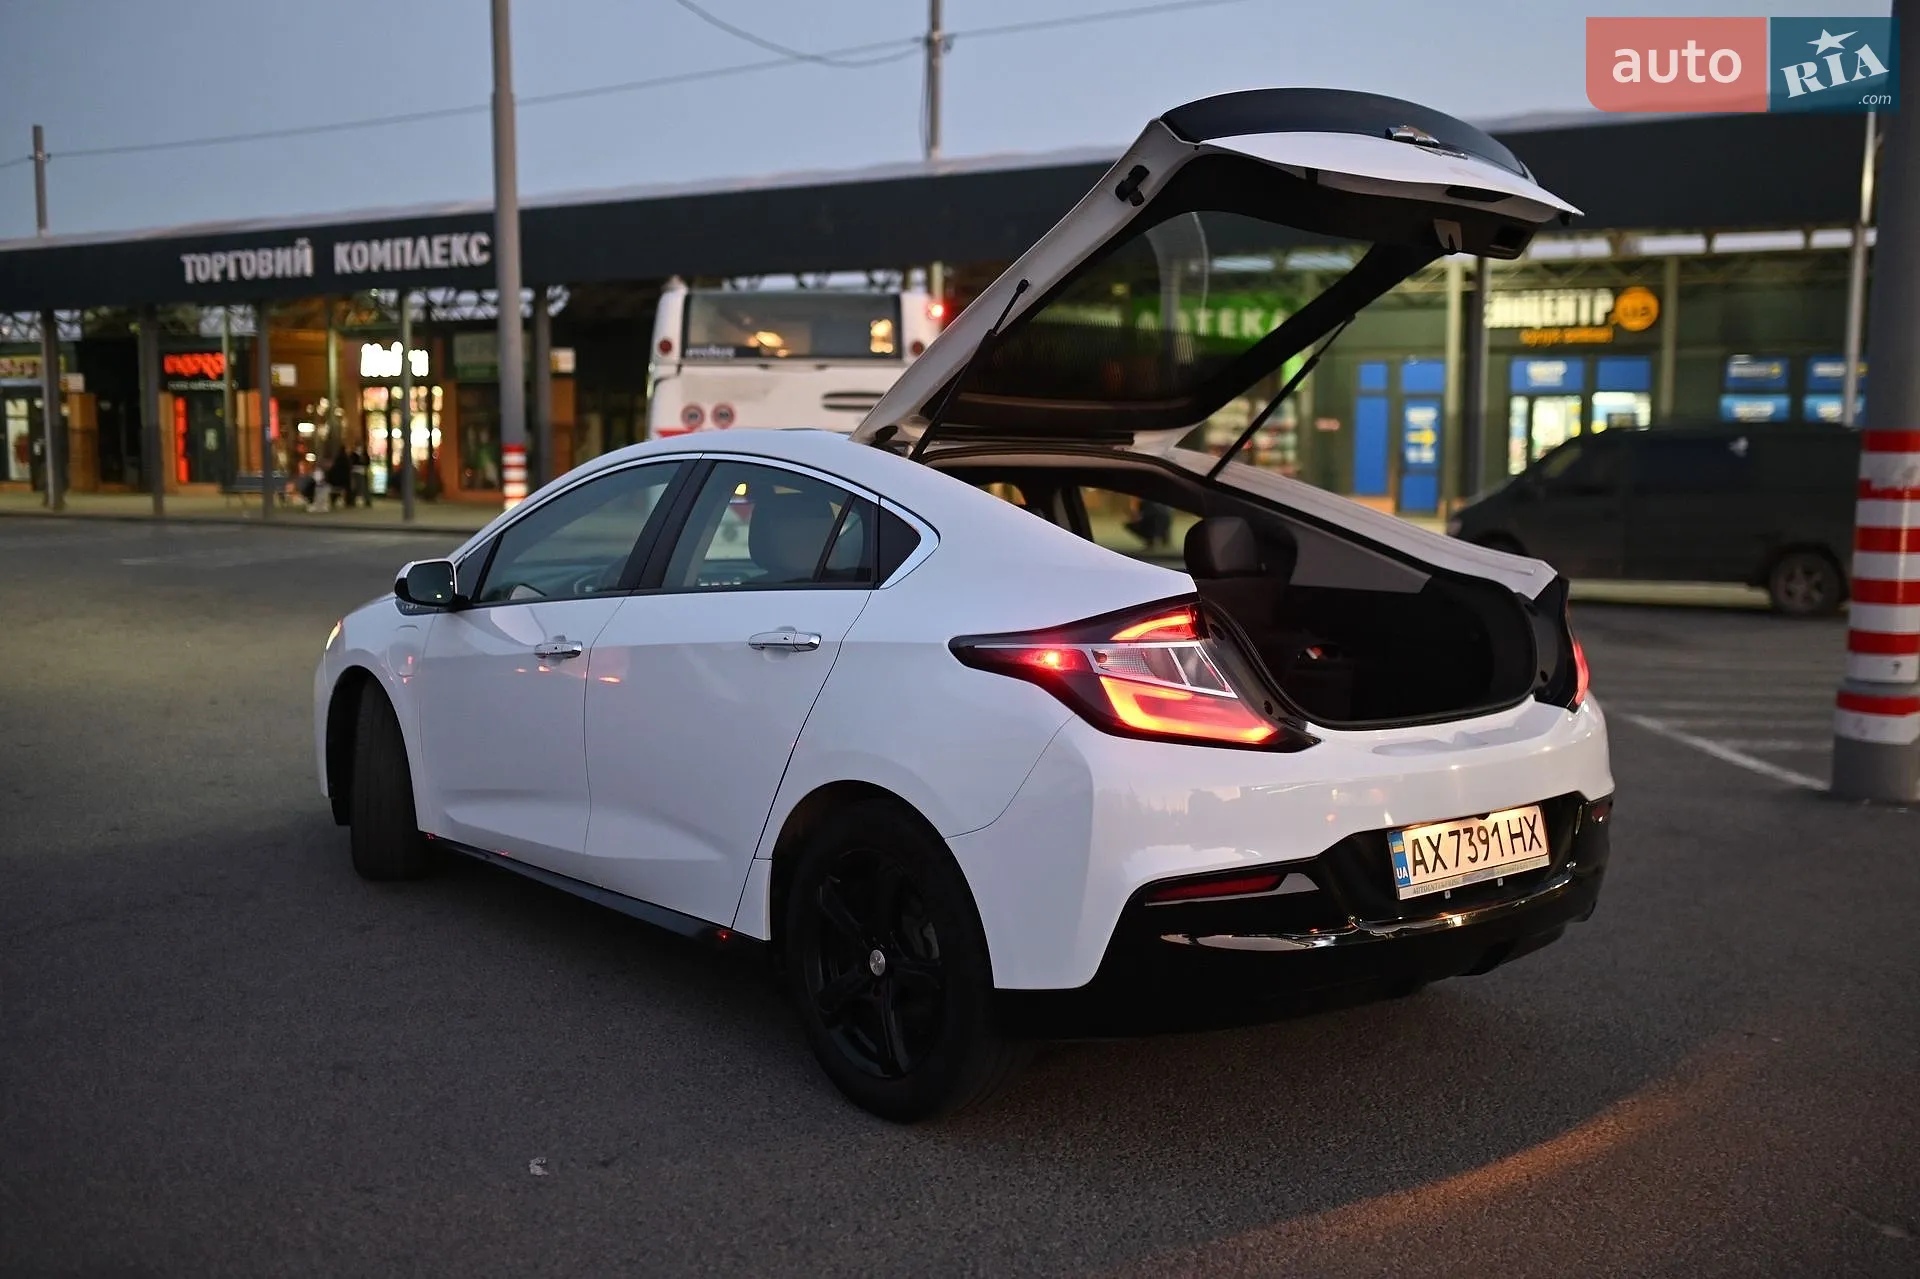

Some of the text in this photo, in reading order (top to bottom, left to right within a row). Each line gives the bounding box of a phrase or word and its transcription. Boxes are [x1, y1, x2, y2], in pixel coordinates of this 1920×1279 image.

[180, 231, 492, 284] ТОРГОВИЙ КОМПЛЕКС
[1411, 815, 1543, 877] AX 7391 HX
[1396, 867, 1409, 880] UA
